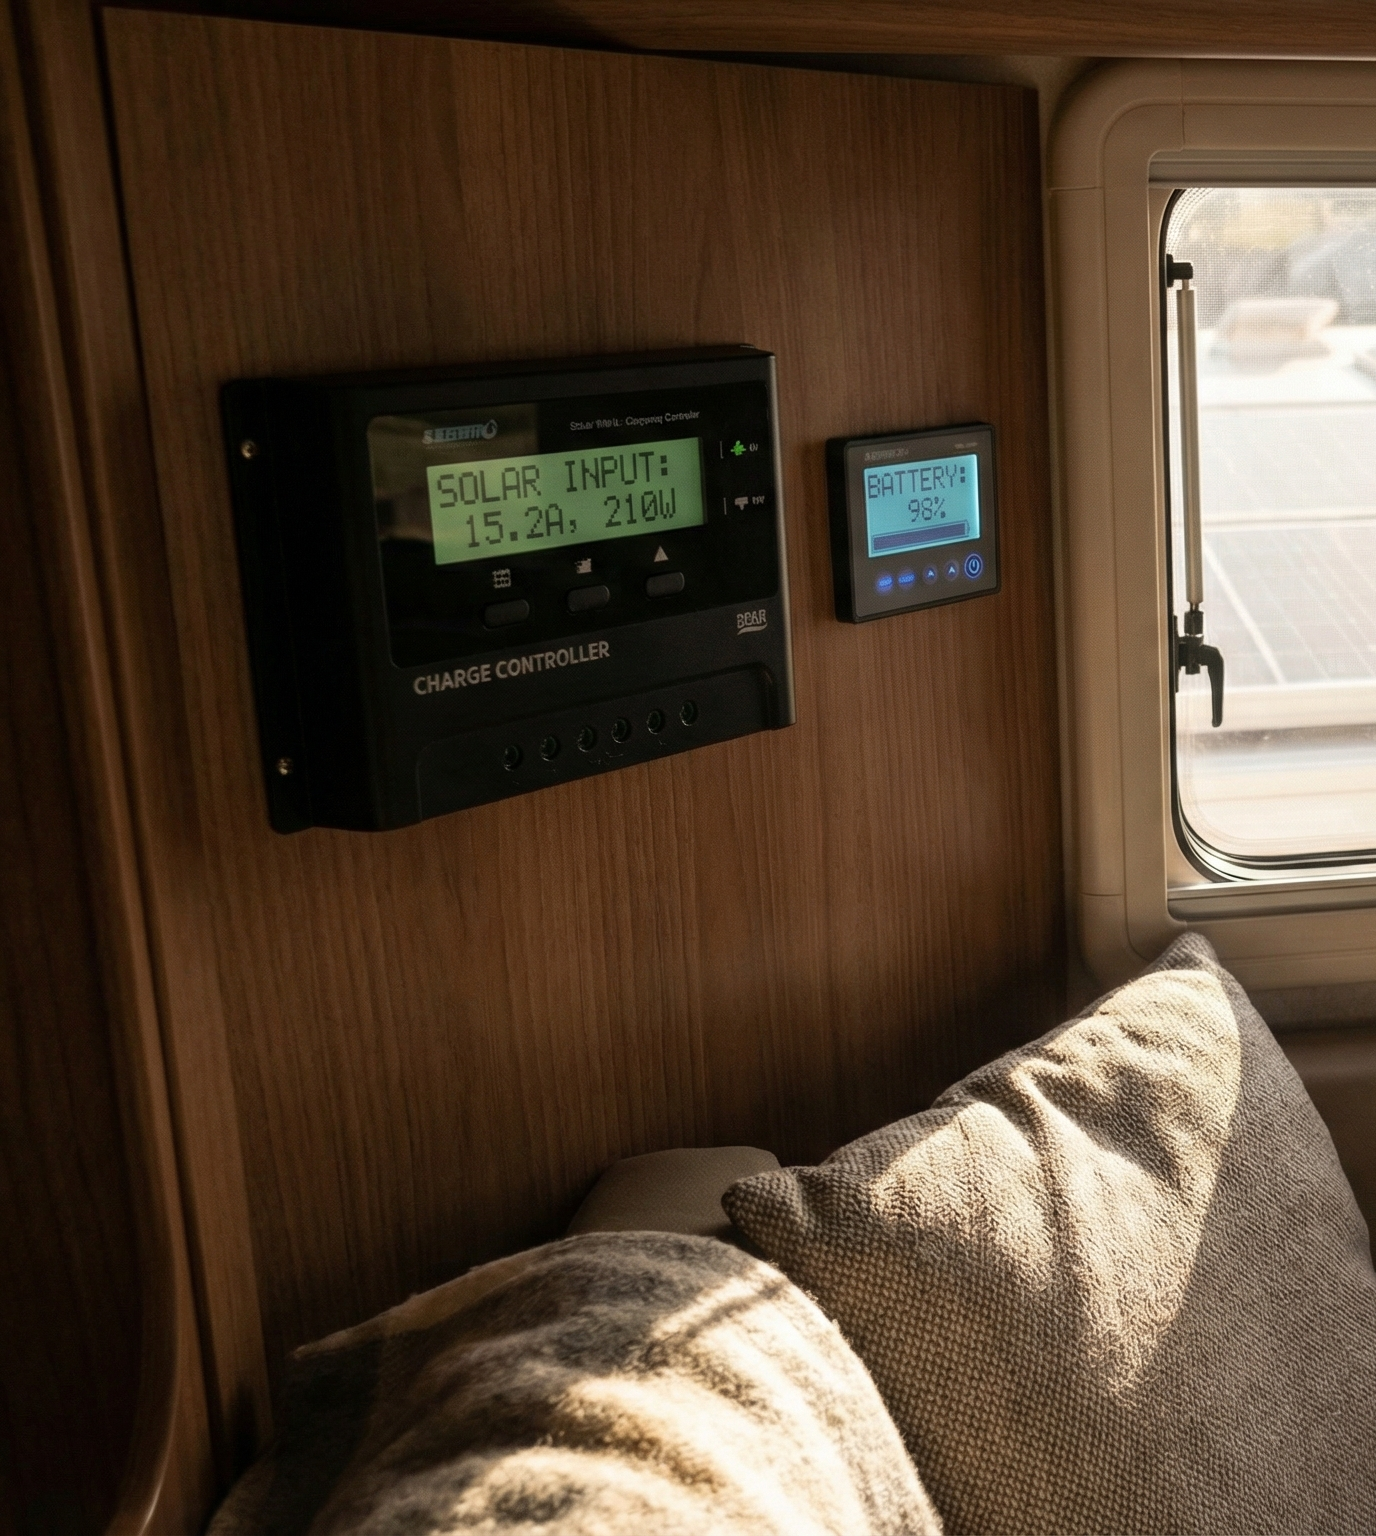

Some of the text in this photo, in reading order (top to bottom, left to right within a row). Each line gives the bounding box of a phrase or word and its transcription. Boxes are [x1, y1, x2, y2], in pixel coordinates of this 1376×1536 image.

[437, 451, 669, 508] SOLAR INPUT:
[868, 464, 966, 499] BATTERY:
[466, 488, 676, 548] 15.2A, 210W
[908, 496, 946, 523] 98%
[413, 641, 610, 695] CHARGE CONTROLLER
